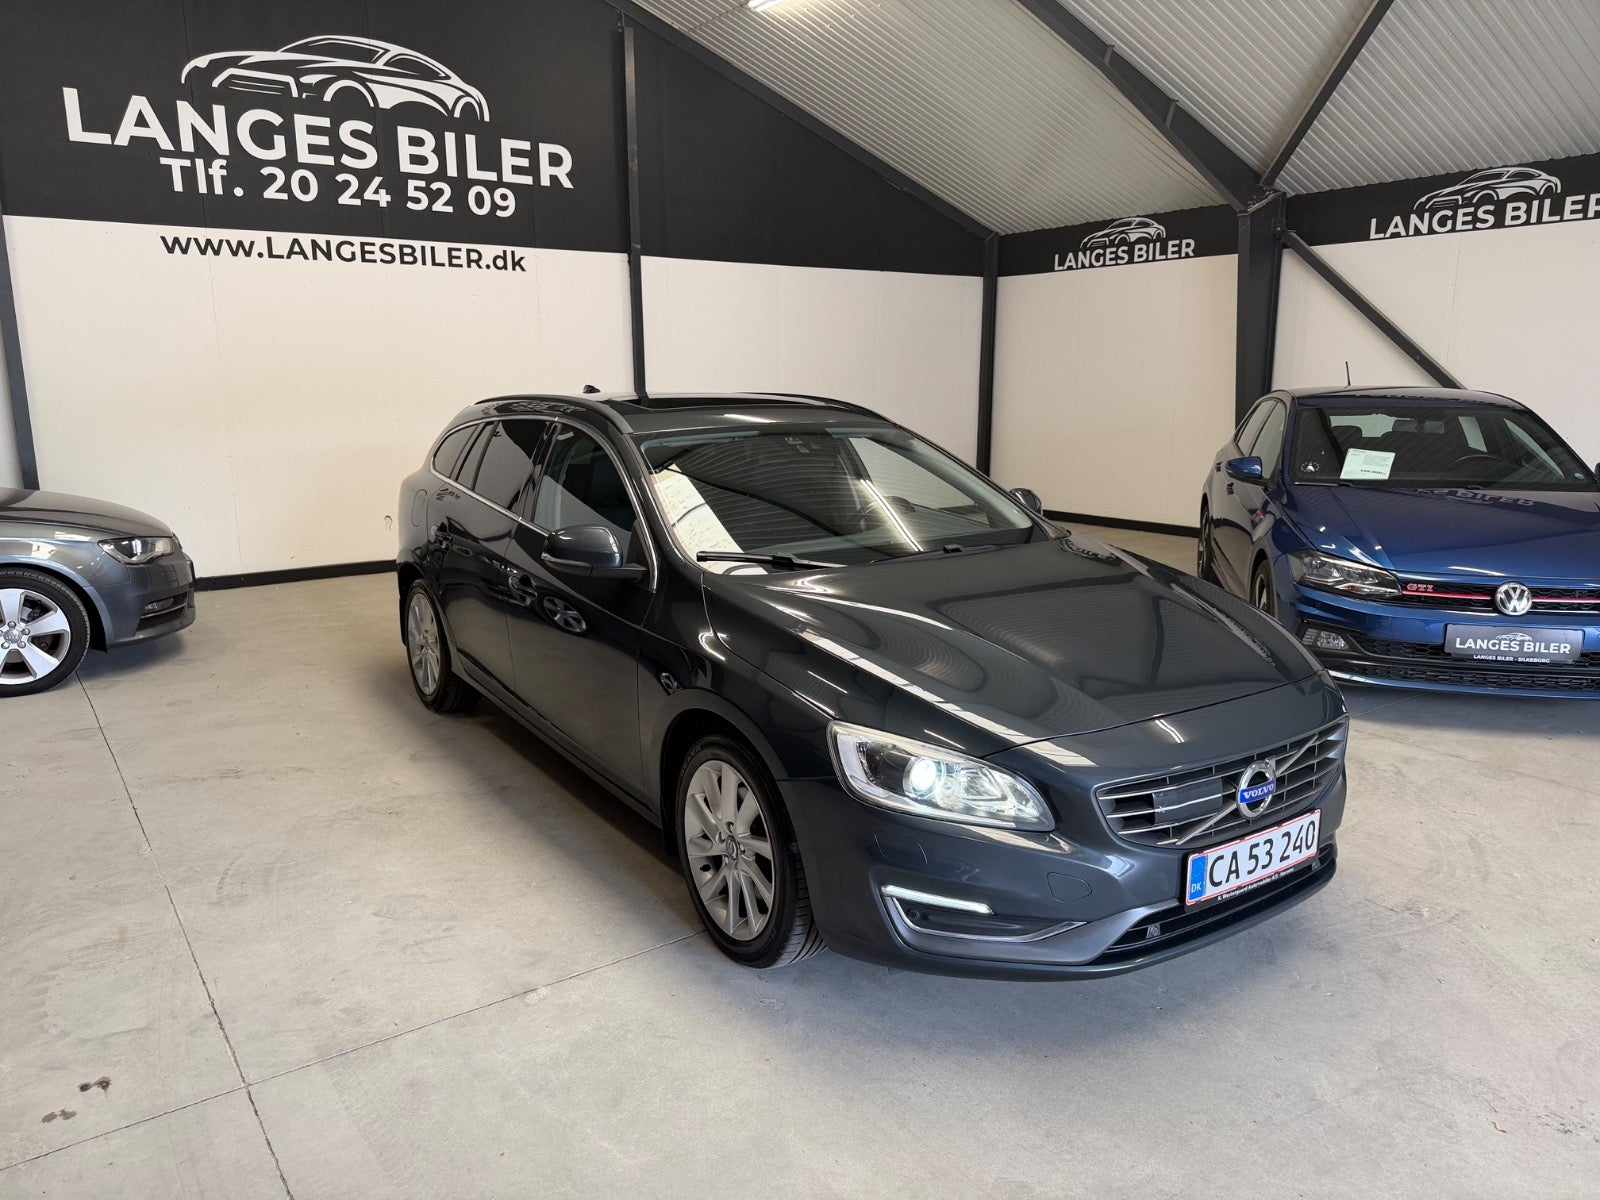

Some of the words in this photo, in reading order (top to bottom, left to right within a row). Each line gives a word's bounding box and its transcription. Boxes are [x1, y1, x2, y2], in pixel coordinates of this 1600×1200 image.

[63, 87, 378, 169] LANGES
[396, 126, 574, 189] BILER
[160, 157, 244, 196] Tlf.
[260, 167, 319, 202] 20
[335, 173, 392, 208] 24
[406, 179, 454, 213] 52
[468, 186, 516, 218] 09
[1371, 205, 1495, 239] LANGES
[160, 235, 527, 272] www.LANGESBILER.dk
[1054, 246, 1129, 271] LANGES
[1133, 238, 1196, 263] BILER
[1406, 582, 1434, 592] GTI
[1455, 637, 1520, 652] LANGES
[1523, 641, 1571, 655] BILER
[1473, 654, 1497, 662] LANGES
[1243, 783, 1275, 800] VOLVO
[1209, 850, 1240, 888] CA
[1247, 838, 1274, 876] 53
[1280, 820, 1316, 863] 240
[1191, 882, 1202, 894] DK
